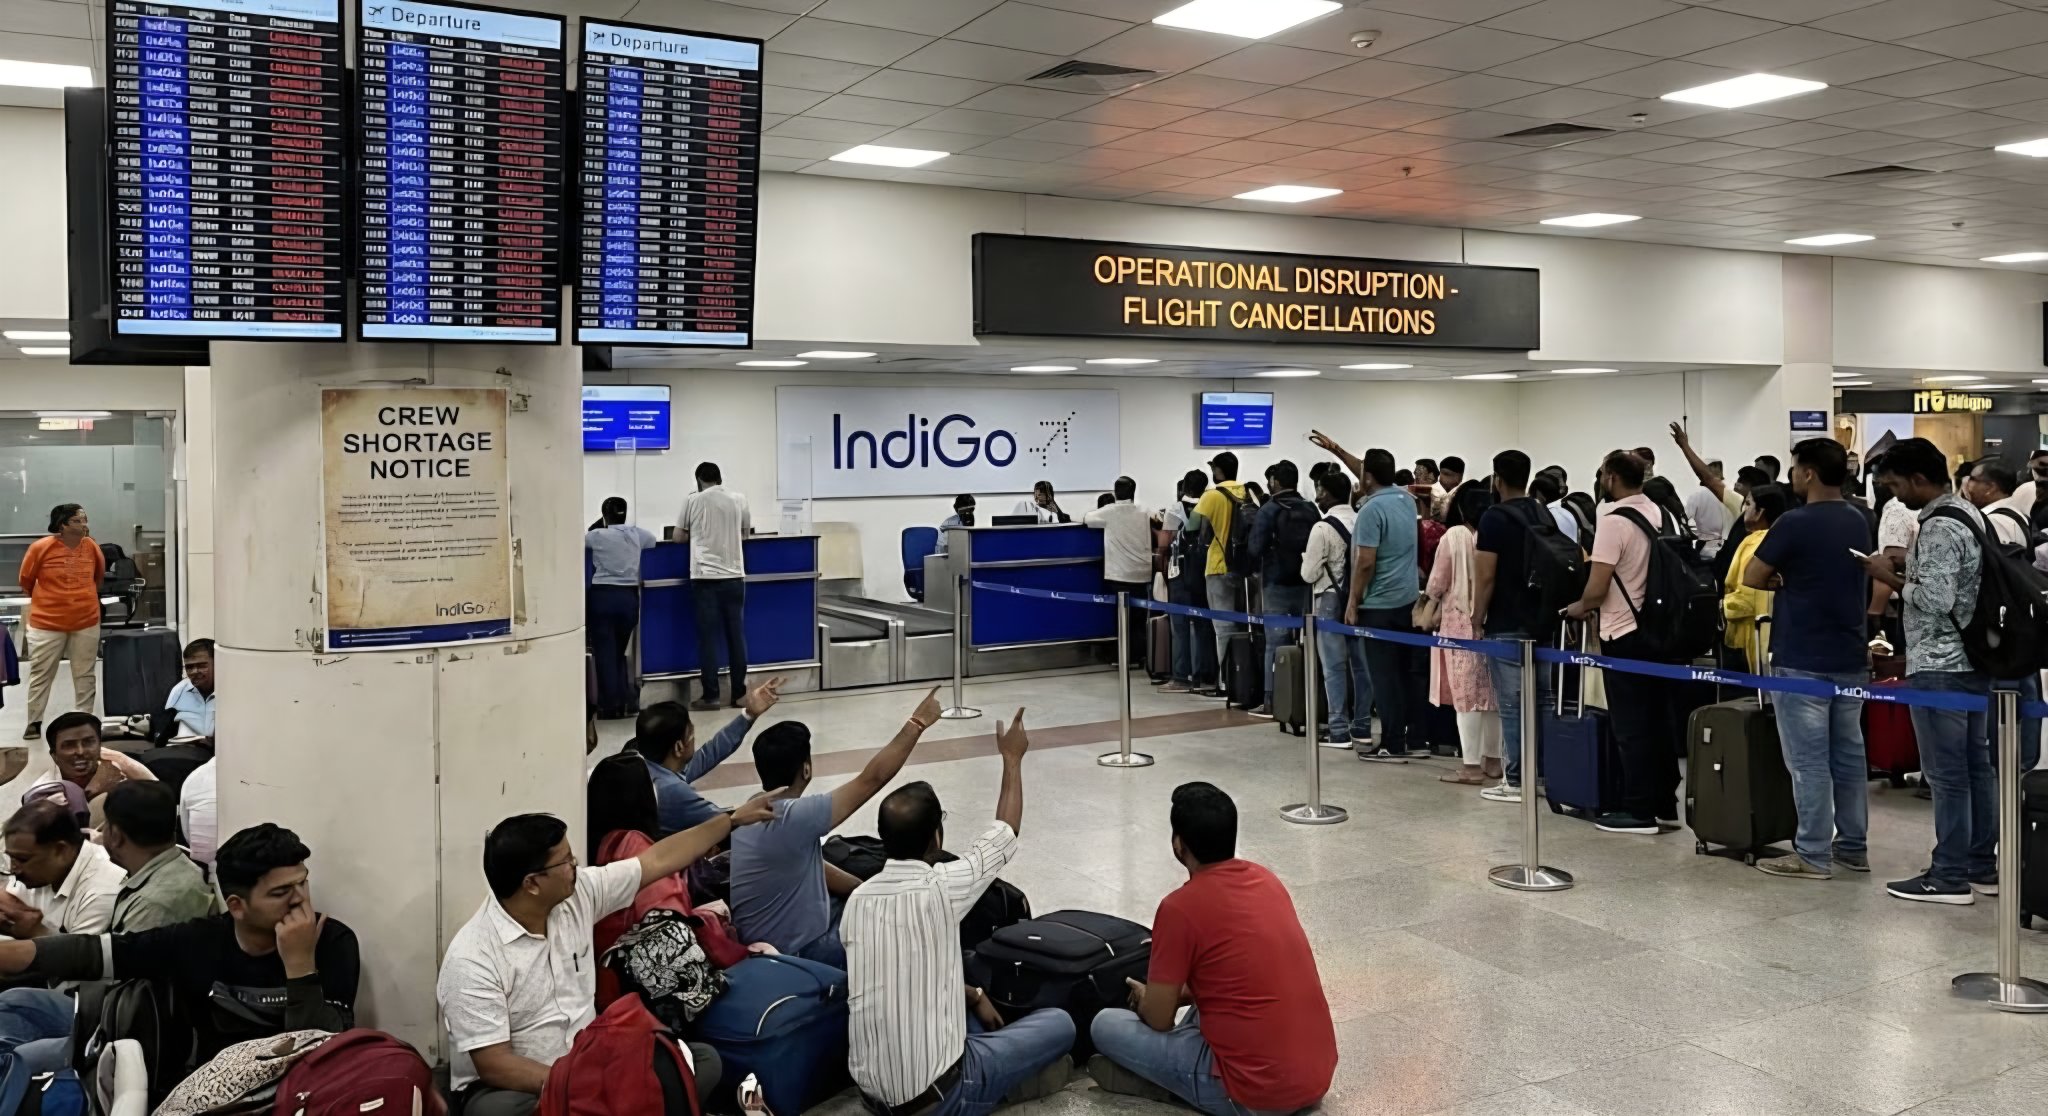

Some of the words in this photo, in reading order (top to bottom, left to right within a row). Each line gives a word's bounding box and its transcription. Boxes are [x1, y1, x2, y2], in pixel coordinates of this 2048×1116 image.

[392, 7, 481, 31] Departure
[1093, 255, 1289, 293] OPERATIONAL
[1294, 267, 1445, 300] DISRUPTION
[1123, 296, 1223, 328] FLIGHT
[1229, 300, 1436, 336] CANCELLATIONS
[378, 406, 460, 426] CREW
[343, 432, 492, 453] SHORTAGE
[833, 413, 1017, 470] IndiGo
[370, 458, 471, 480] NOTICE
